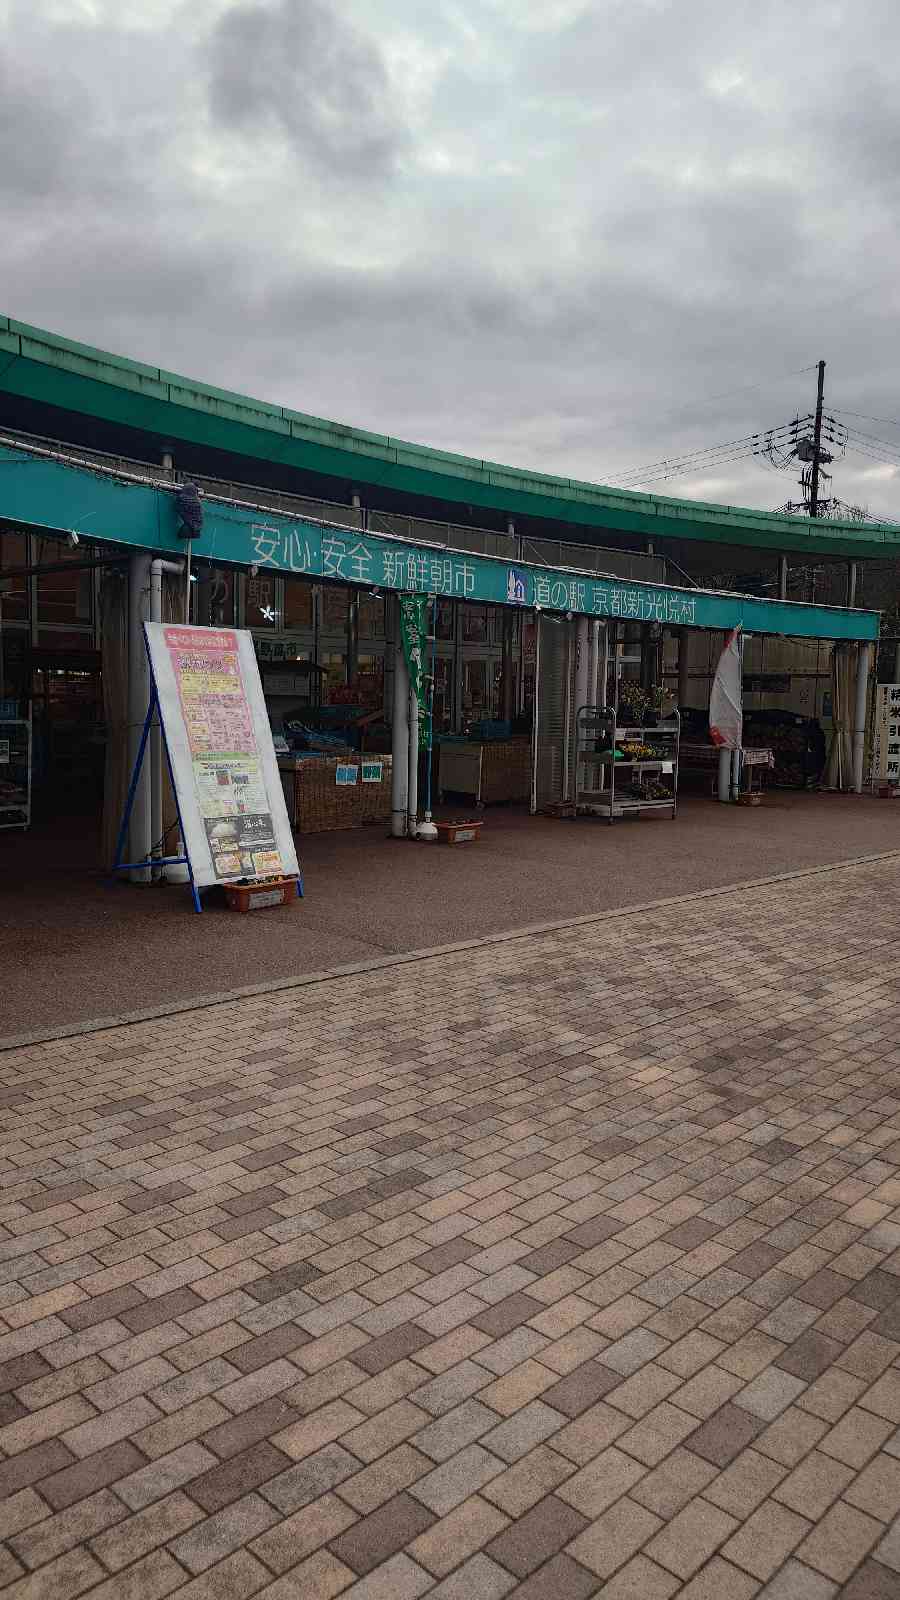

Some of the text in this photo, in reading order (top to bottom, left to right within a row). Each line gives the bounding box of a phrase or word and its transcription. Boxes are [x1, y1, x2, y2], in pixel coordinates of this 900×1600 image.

[383, 549, 476, 597] 新鮮朝市
[532, 575, 697, 625] 道の駅 京都新光悦村
